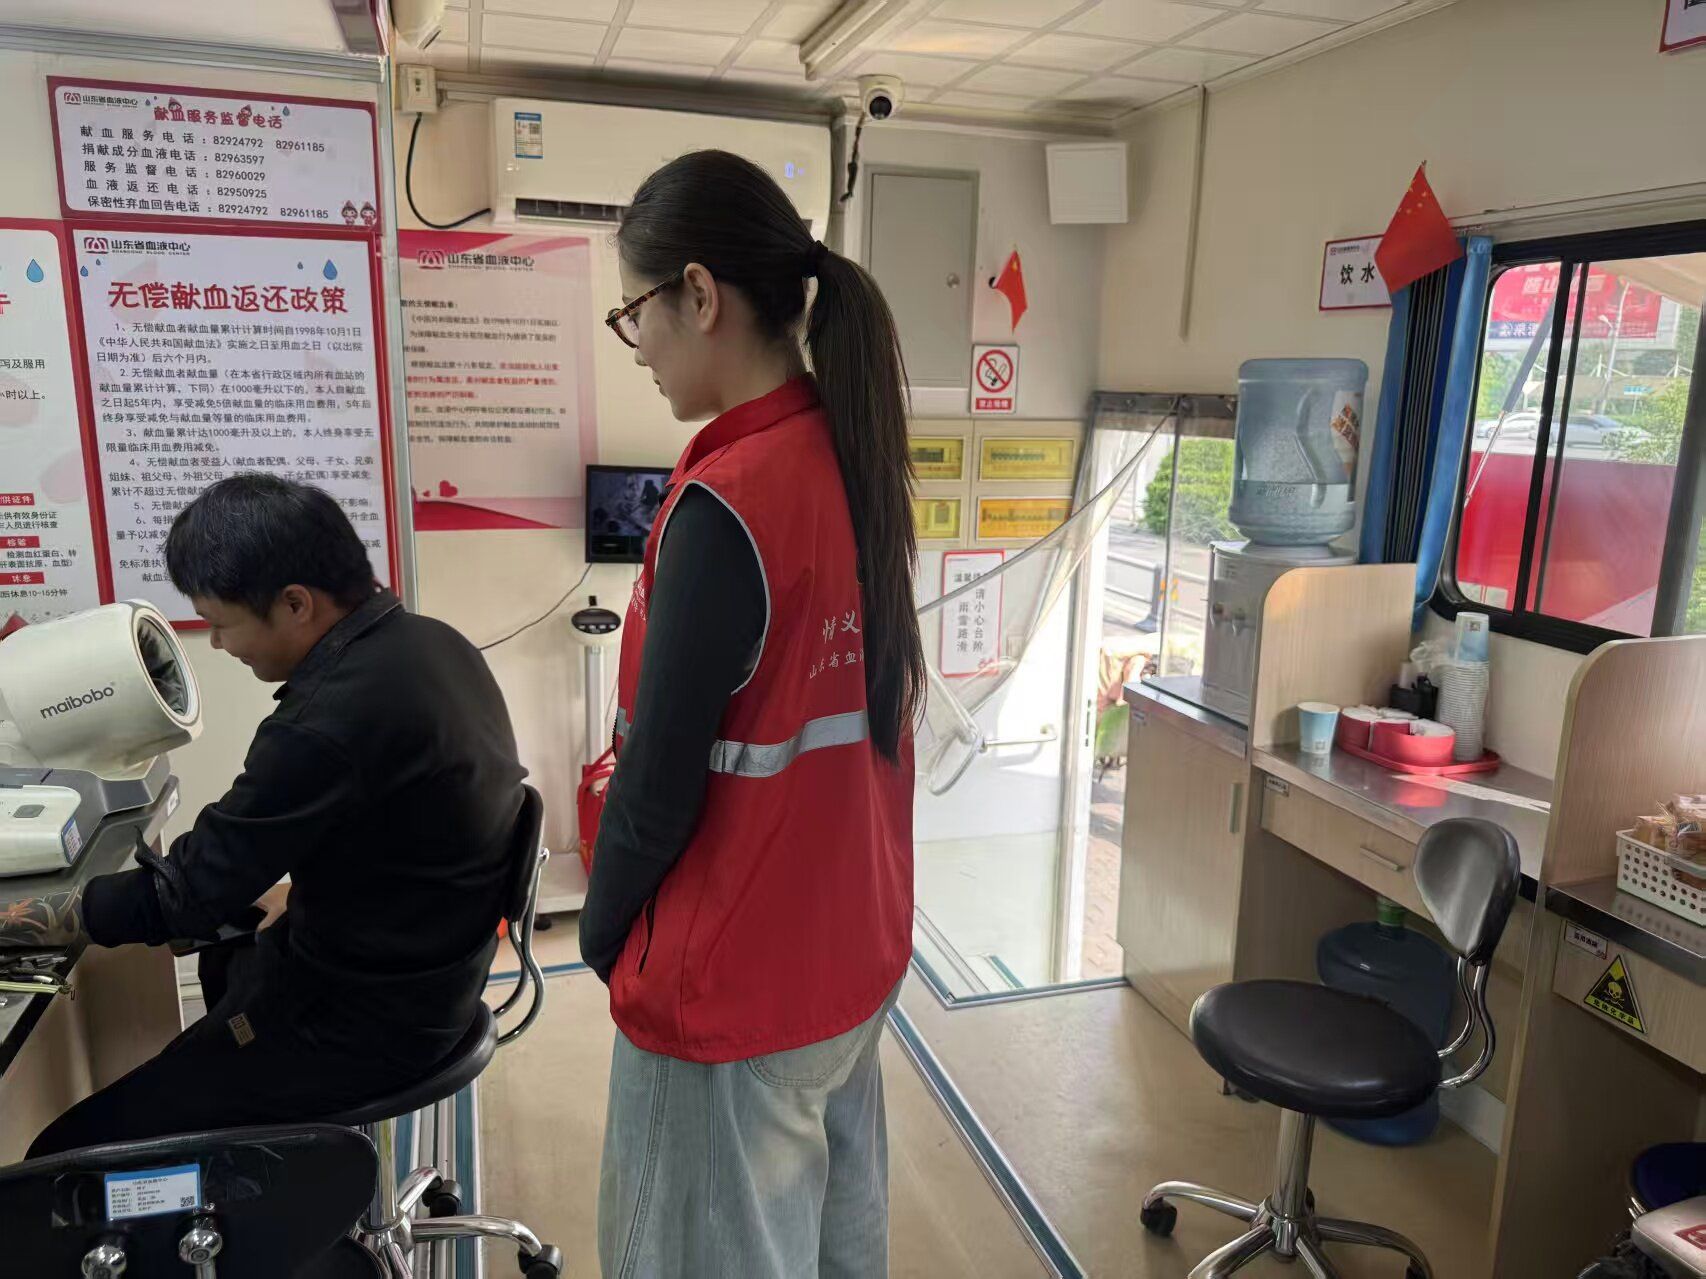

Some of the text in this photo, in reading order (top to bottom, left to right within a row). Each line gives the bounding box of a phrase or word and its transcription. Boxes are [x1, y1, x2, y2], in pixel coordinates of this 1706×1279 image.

[154, 105, 282, 129] 献血服务监督电话
[213, 135, 264, 148] 82924792
[275, 140, 325, 152] 82961185
[214, 152, 265, 165] 82963597
[215, 169, 266, 181] 82960029
[217, 186, 267, 199] 82950925
[218, 203, 269, 216] 82924792
[280, 207, 329, 219] 82961185
[111, 239, 191, 252] 山东省血液中心
[446, 254, 535, 266] 山东省血液中心
[108, 281, 348, 315] 无偿献血返还政策
[0, 494, 32, 504] 供证件
[40, 687, 114, 719] maibobo
